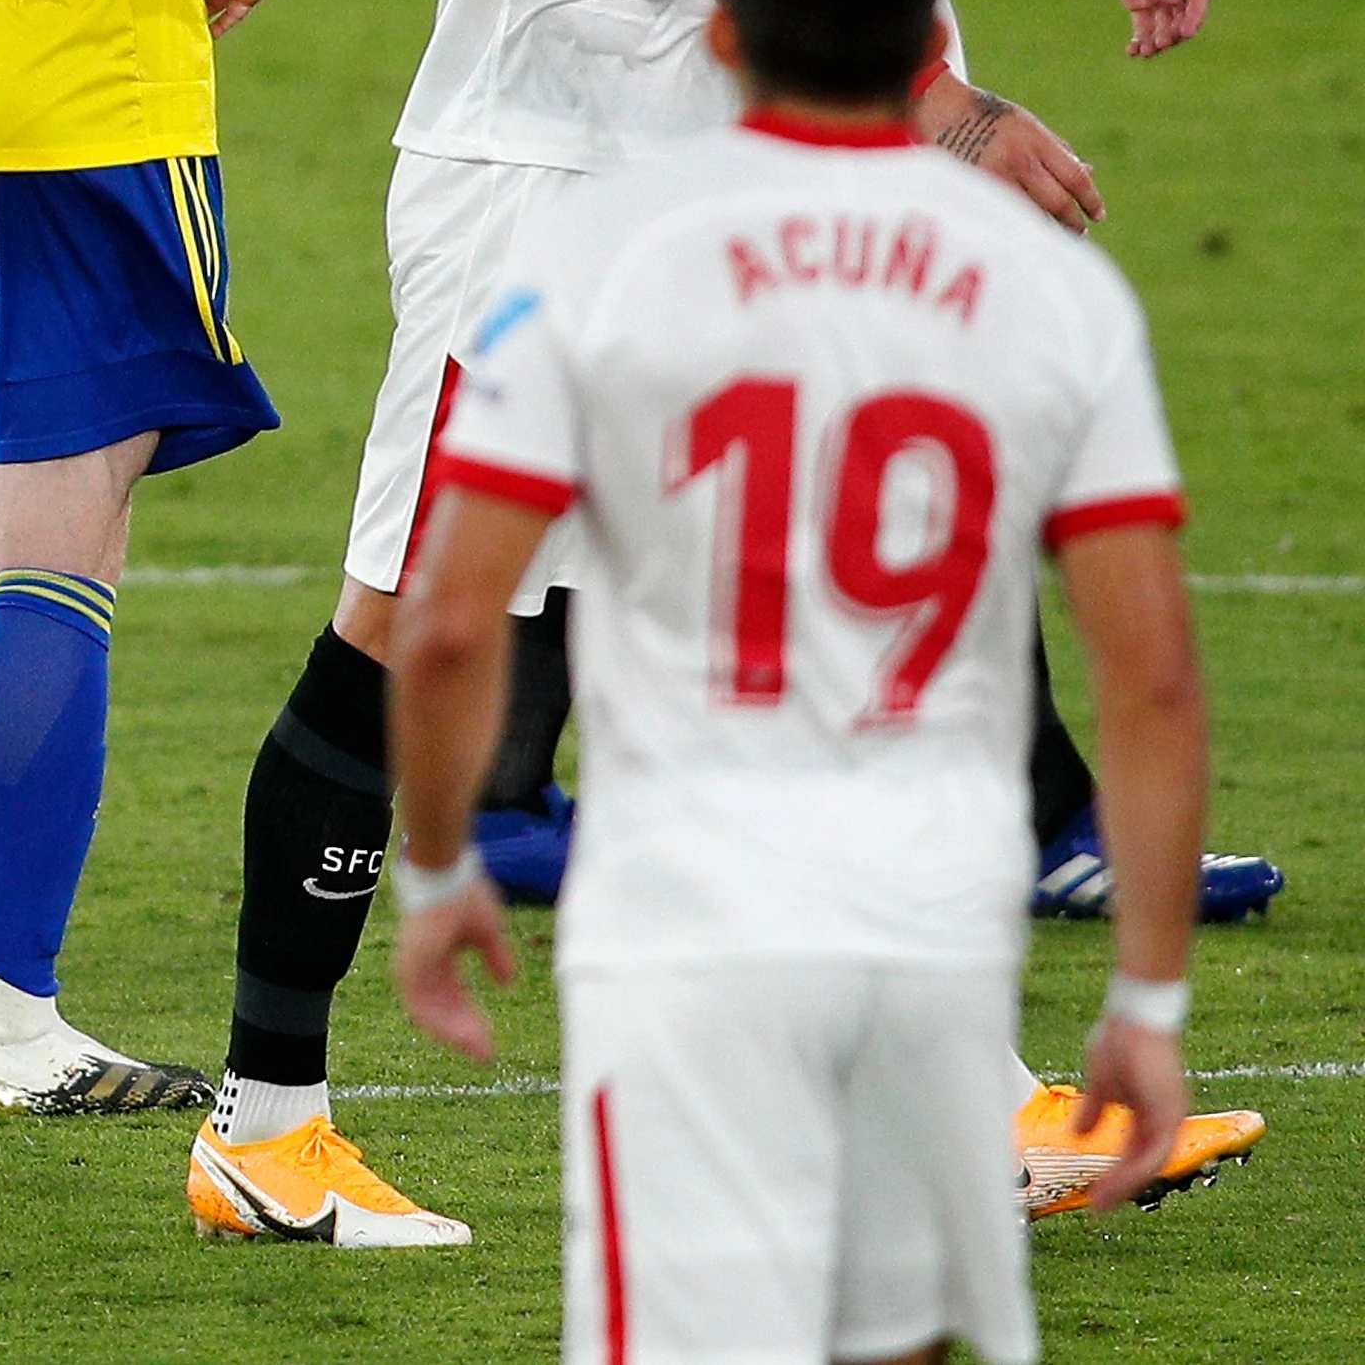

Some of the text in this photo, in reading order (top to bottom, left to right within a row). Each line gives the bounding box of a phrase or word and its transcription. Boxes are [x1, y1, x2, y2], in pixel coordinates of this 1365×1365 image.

[725, 209, 988, 326] ACUÑA
[661, 374, 997, 734] 19
[322, 846, 384, 874] SFC
